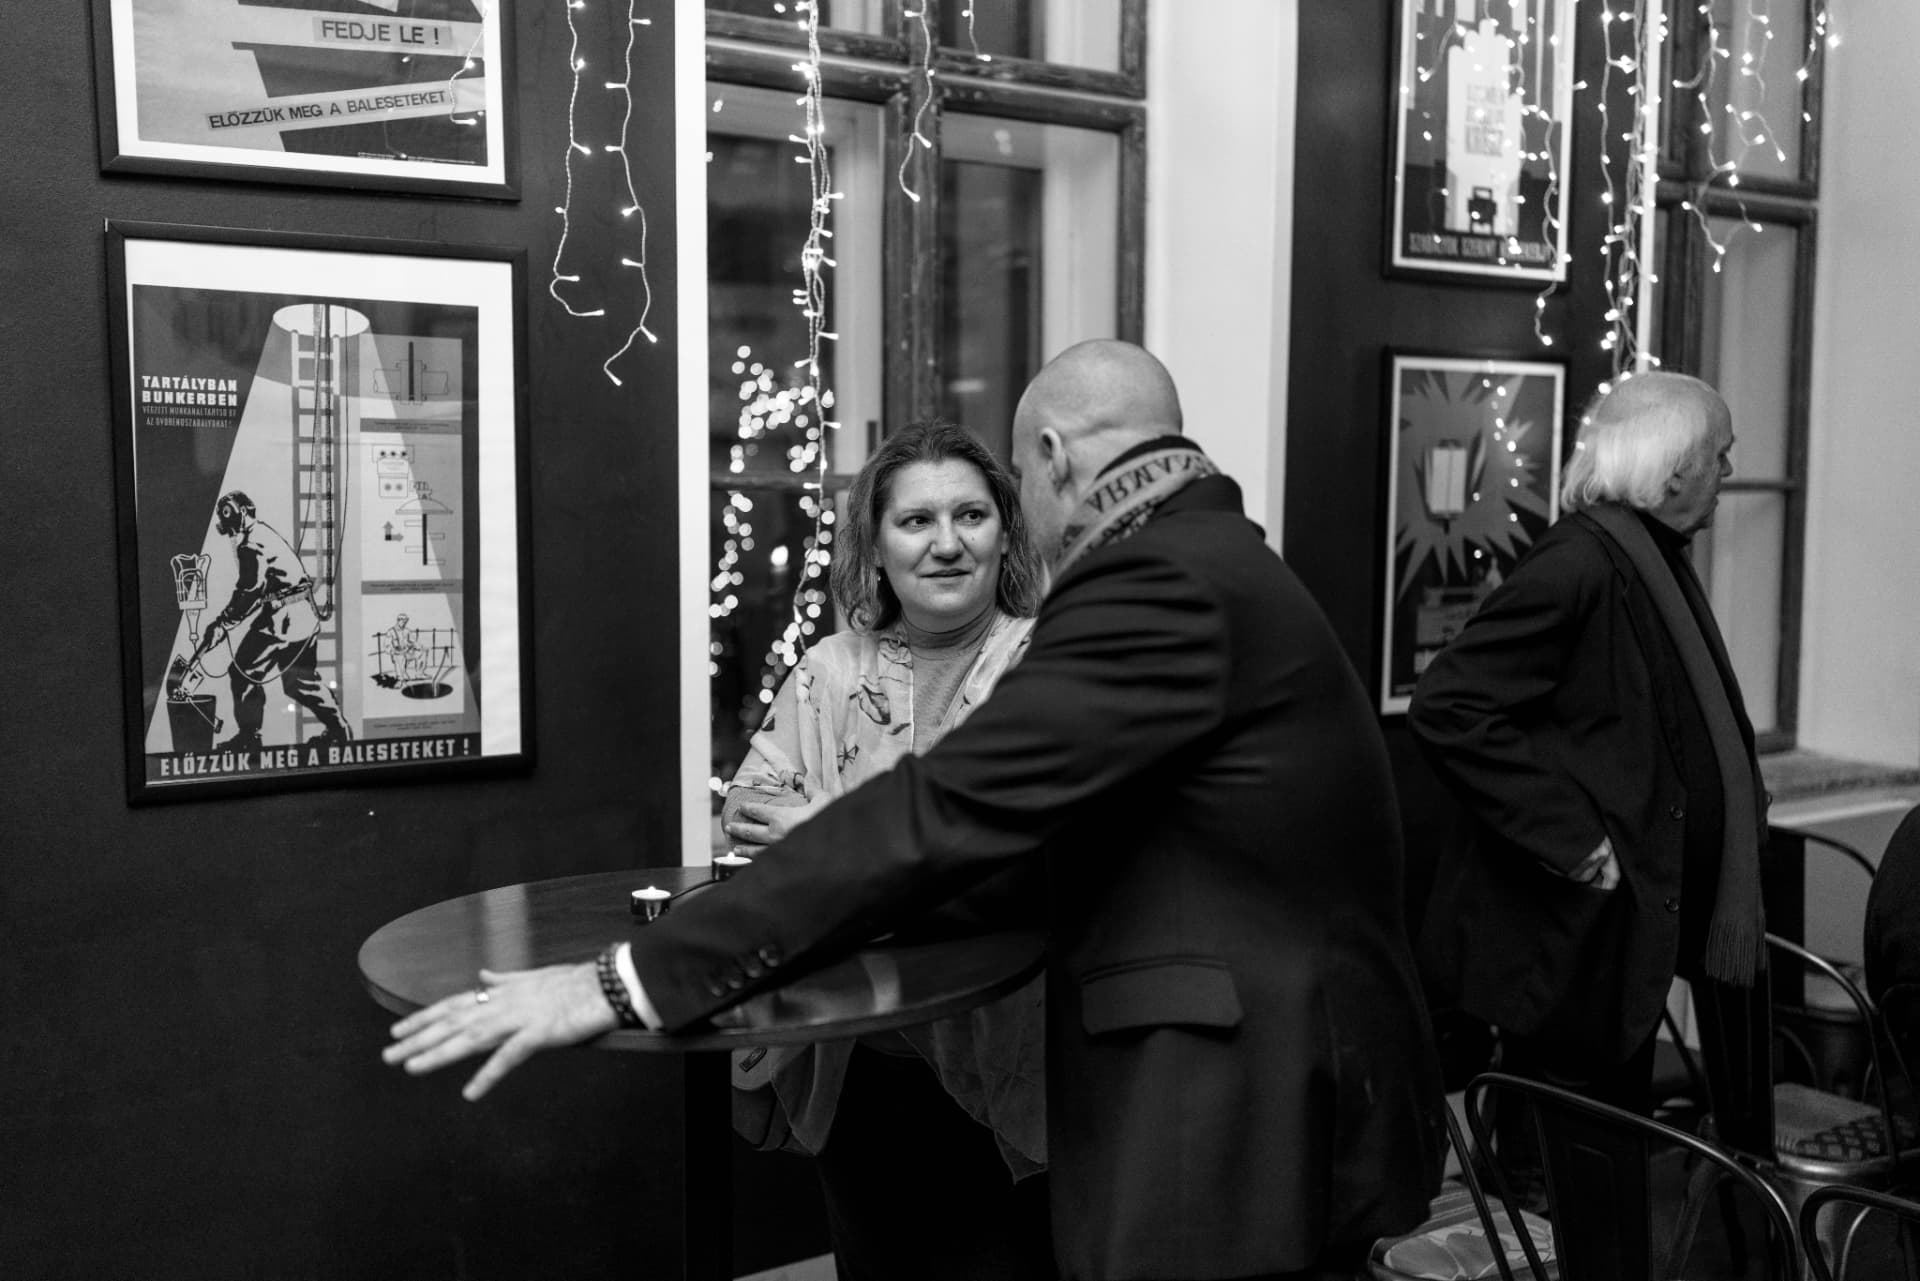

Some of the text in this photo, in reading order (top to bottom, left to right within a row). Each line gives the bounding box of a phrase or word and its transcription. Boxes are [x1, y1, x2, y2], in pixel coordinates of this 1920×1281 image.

[321, 20, 391, 42] FEDJE
[401, 26, 425, 44] LE
[289, 104, 324, 120] MEG
[329, 103, 342, 116] A
[347, 91, 446, 113] BALESETEKET
[142, 375, 237, 392] TARTÁLYBAN
[142, 390, 238, 407] BUNKERBEN
[160, 751, 251, 777] ELŐZZÜK
[260, 749, 299, 770] MEG
[307, 748, 320, 766] A
[328, 740, 456, 765] BALESETEKET
